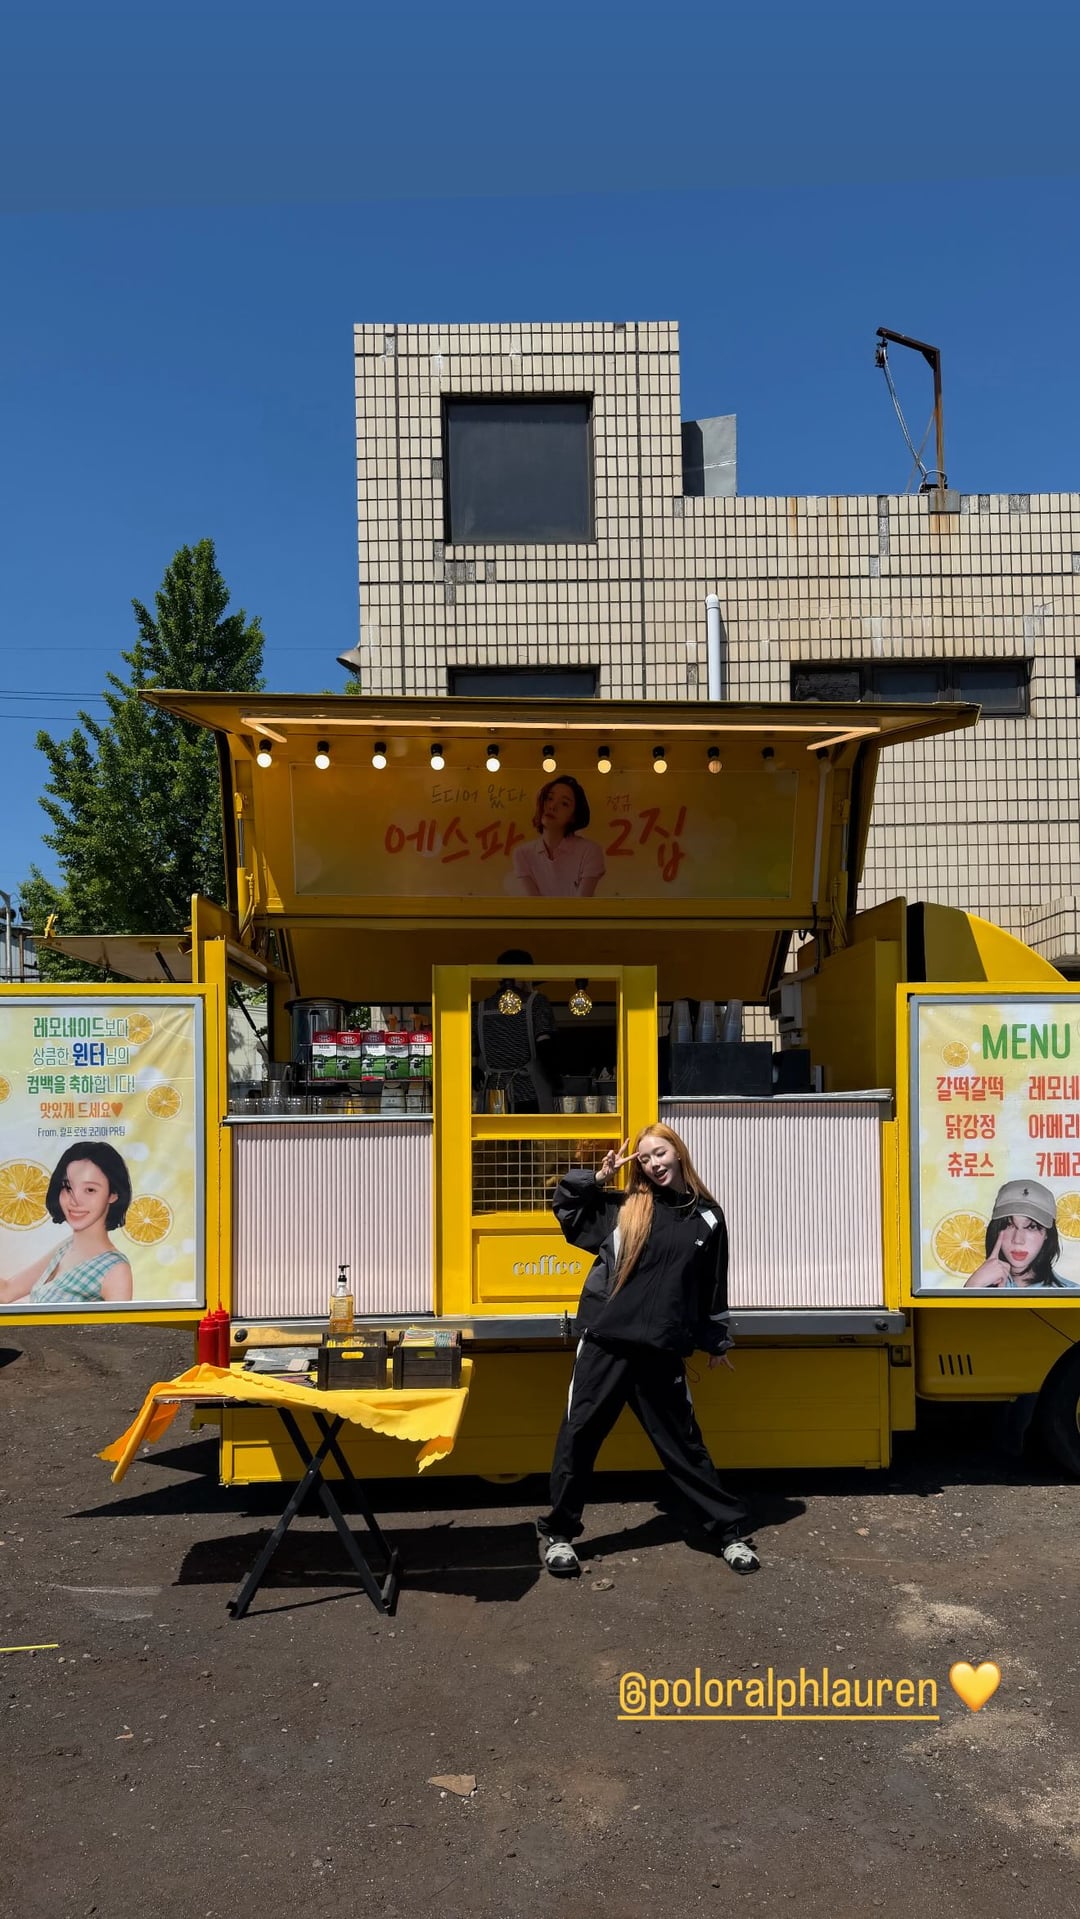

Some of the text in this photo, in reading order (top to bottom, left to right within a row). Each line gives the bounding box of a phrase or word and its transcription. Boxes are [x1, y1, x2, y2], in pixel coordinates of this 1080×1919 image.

[431, 784, 478, 804] 드디어
[384, 805, 687, 882] 에스파 2집
[33, 1017, 129, 1038] 레모네이드보다
[982, 1023, 1070, 1060] MENU
[33, 1043, 130, 1066] 상큼한 윈터님의
[27, 1074, 135, 1094] 컴백을 축하합니다!
[936, 1076, 1004, 1101] 갈떡갈떡
[1028, 1075, 1080, 1100] 레모네
[40, 1102, 75, 1119] 맛있게
[945, 1114, 996, 1140] 닭강정
[1028, 1114, 1080, 1139] 아메리
[948, 1152, 995, 1177] 츄로스
[512, 1254, 581, 1276] coffee
